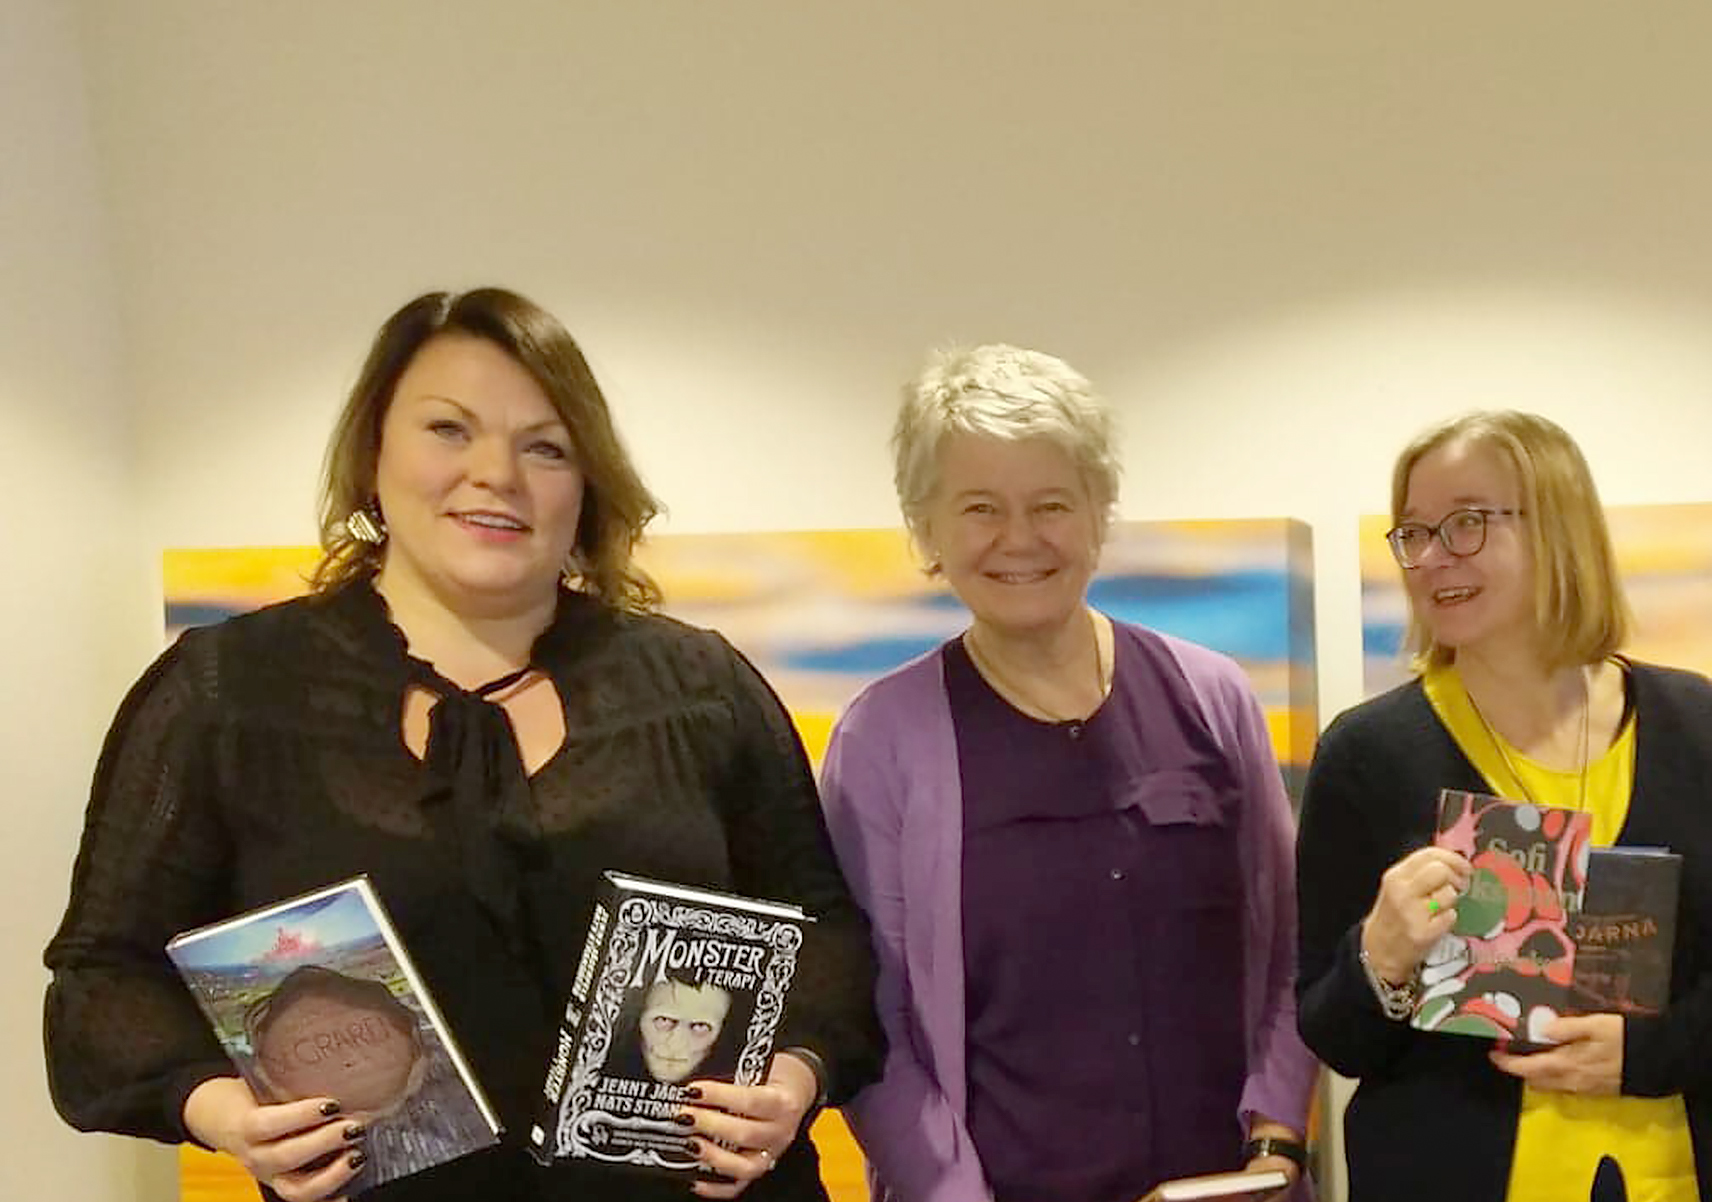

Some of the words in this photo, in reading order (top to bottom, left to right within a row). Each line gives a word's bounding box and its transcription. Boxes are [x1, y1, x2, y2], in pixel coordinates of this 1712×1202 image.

[629, 928, 767, 989] MONSTER
[706, 968, 757, 990] TERAPI
[600, 1075, 648, 1097] JENNY
[595, 1094, 631, 1113] MATS
